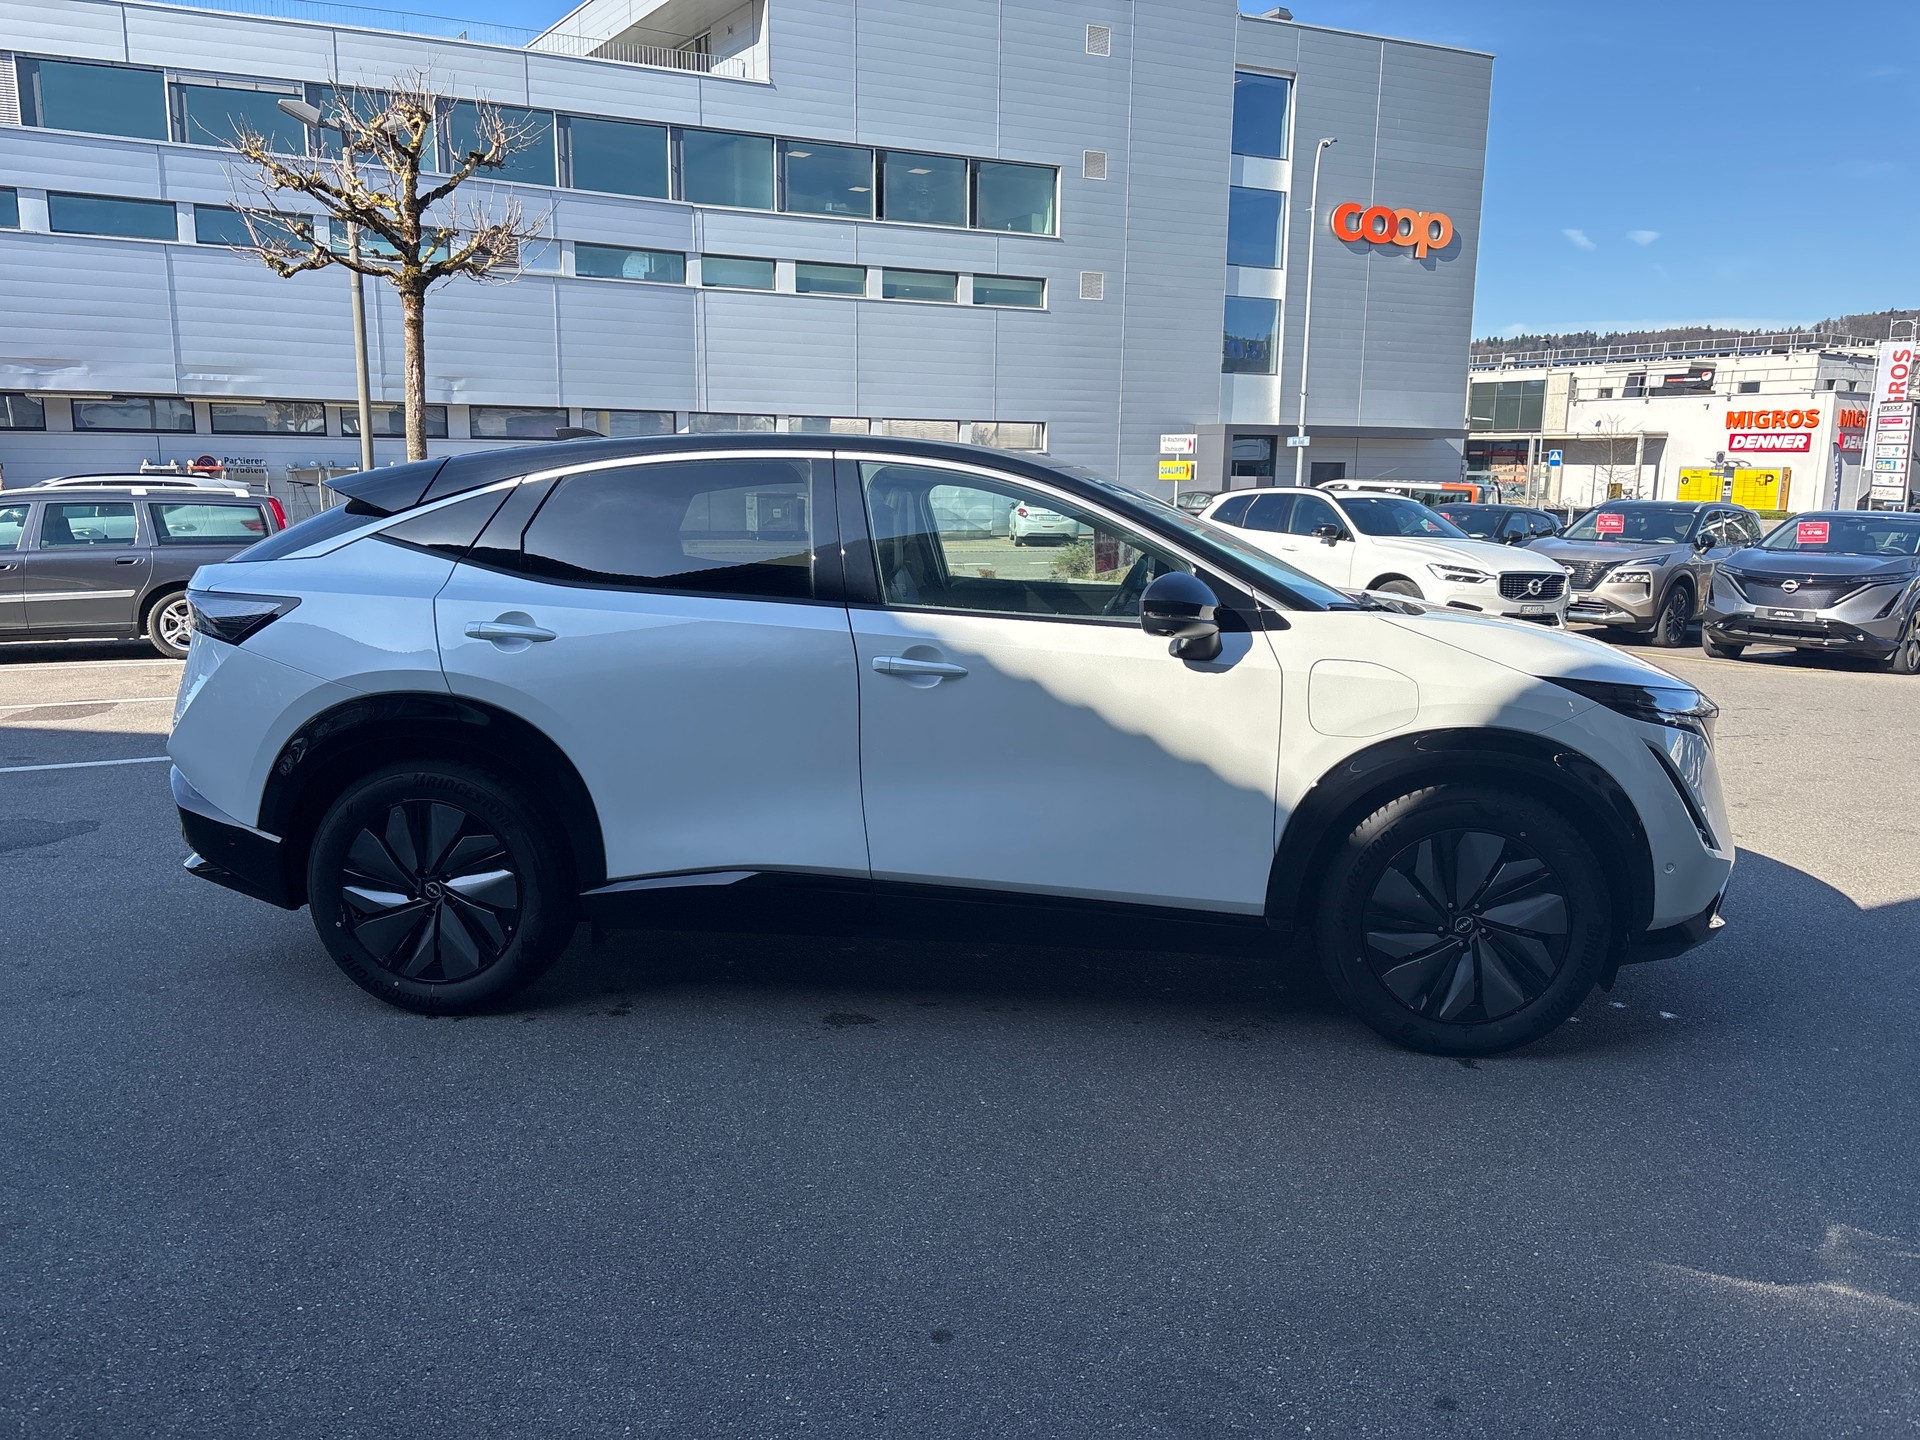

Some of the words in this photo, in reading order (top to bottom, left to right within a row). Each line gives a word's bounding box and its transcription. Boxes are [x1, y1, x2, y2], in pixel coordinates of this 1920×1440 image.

[1331, 202, 1454, 258] coop
[1887, 350, 1911, 402] ROS
[1725, 409, 1820, 430] MIGROS
[1730, 435, 1808, 449] DENNER
[1160, 466, 1185, 474] QUALIPET
[412, 772, 517, 832] BRIDGESTONE
